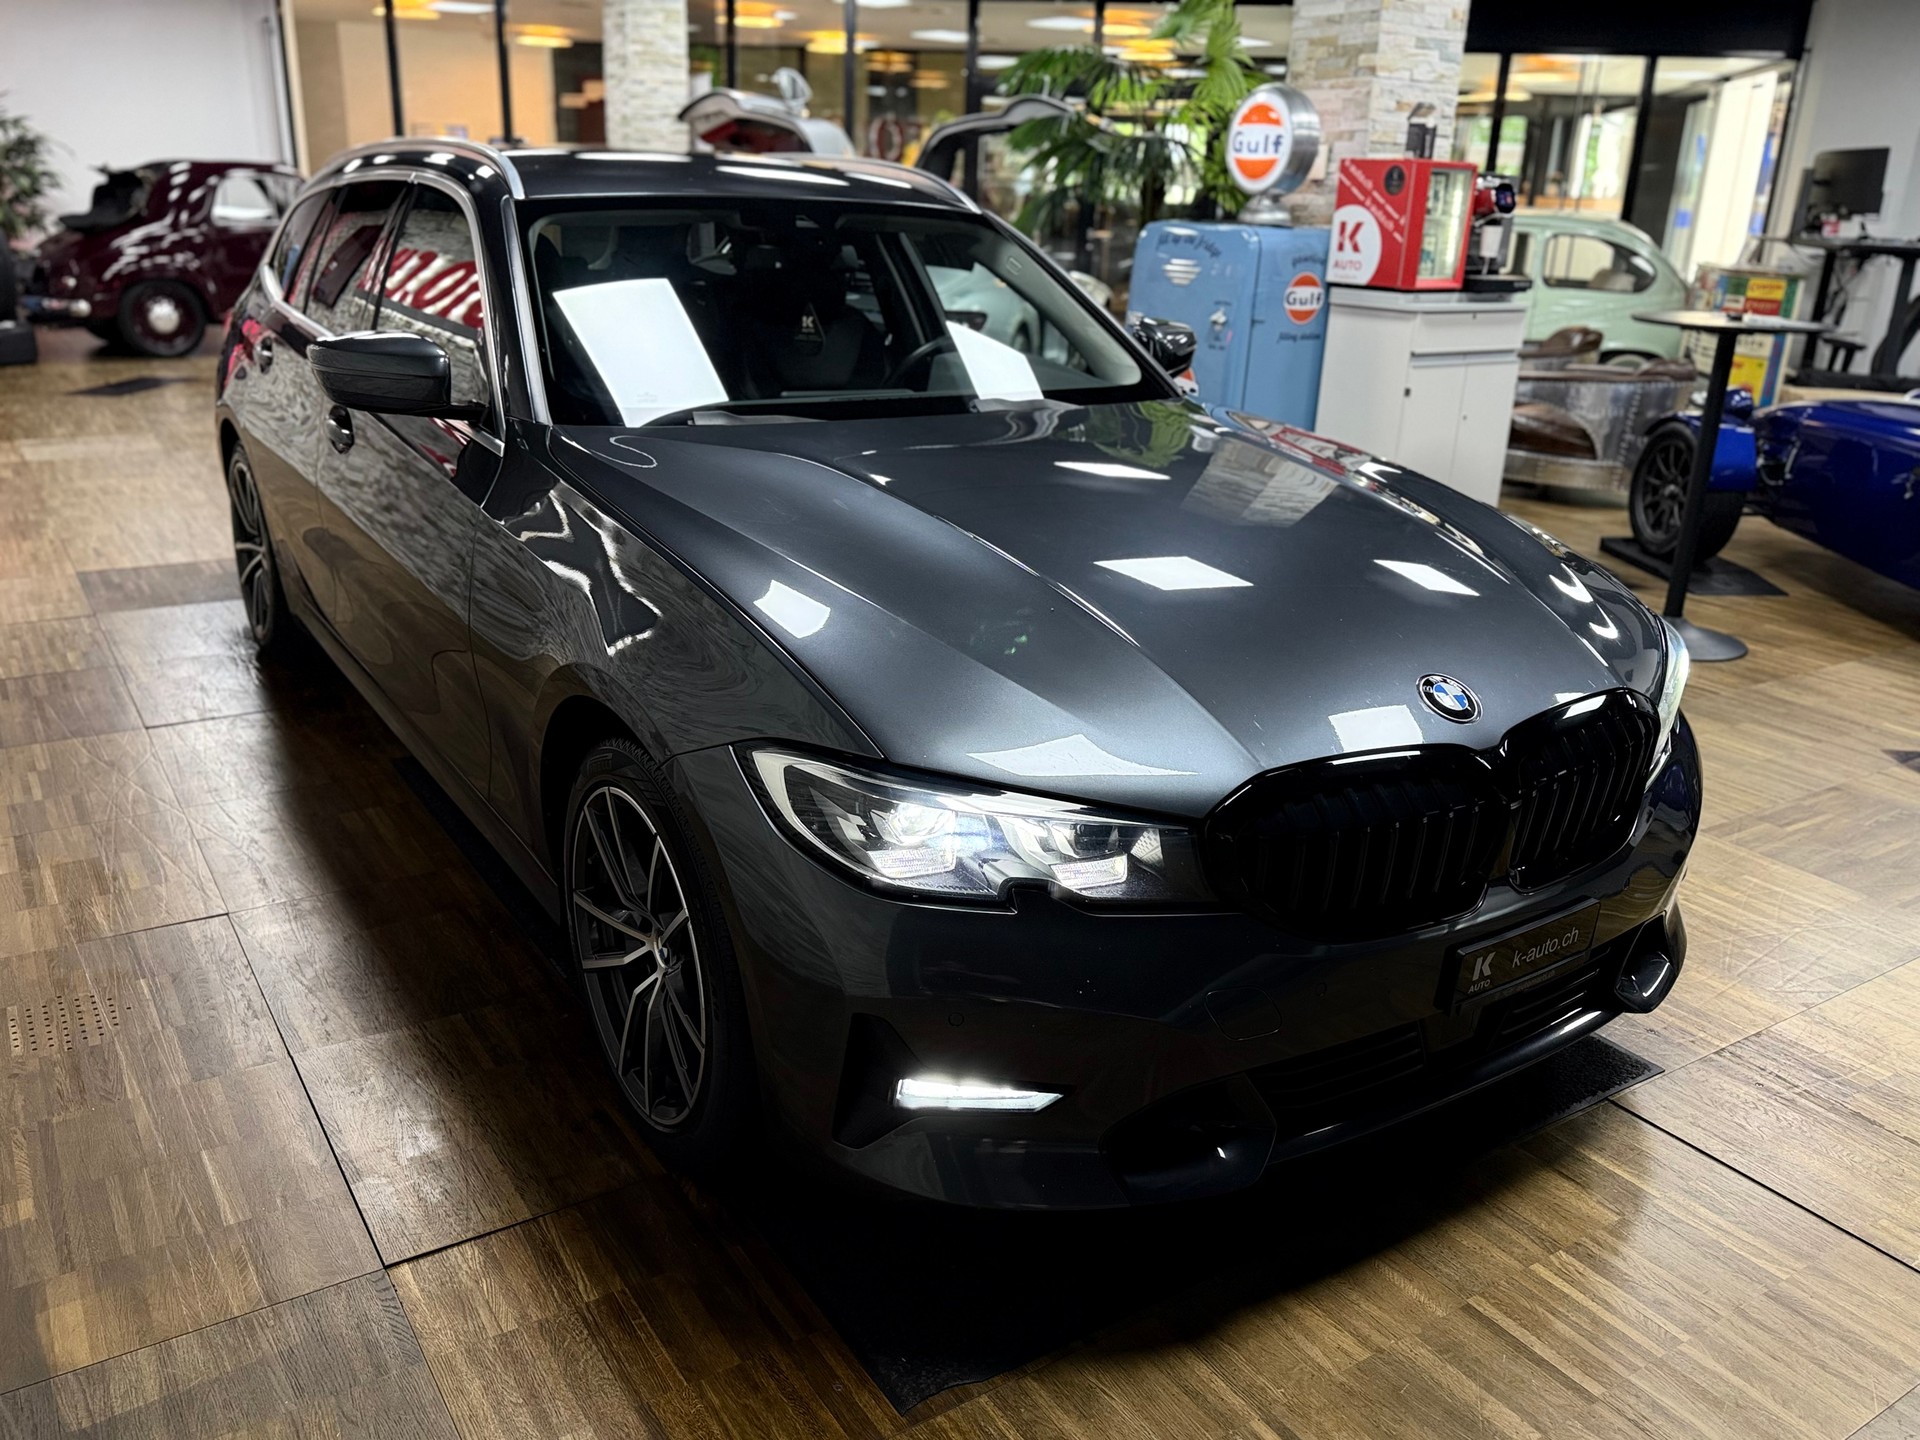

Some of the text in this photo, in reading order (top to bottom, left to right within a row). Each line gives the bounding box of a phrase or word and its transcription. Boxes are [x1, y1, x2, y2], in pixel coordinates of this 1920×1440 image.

[1232, 130, 1284, 155] Gulf
[1337, 220, 1364, 254] K
[1333, 259, 1362, 271] AUTO
[1286, 290, 1323, 306] Gulf
[1511, 926, 1579, 968] k-auto.ch
[1472, 951, 1496, 981] K
[1467, 979, 1491, 994] AUTO
